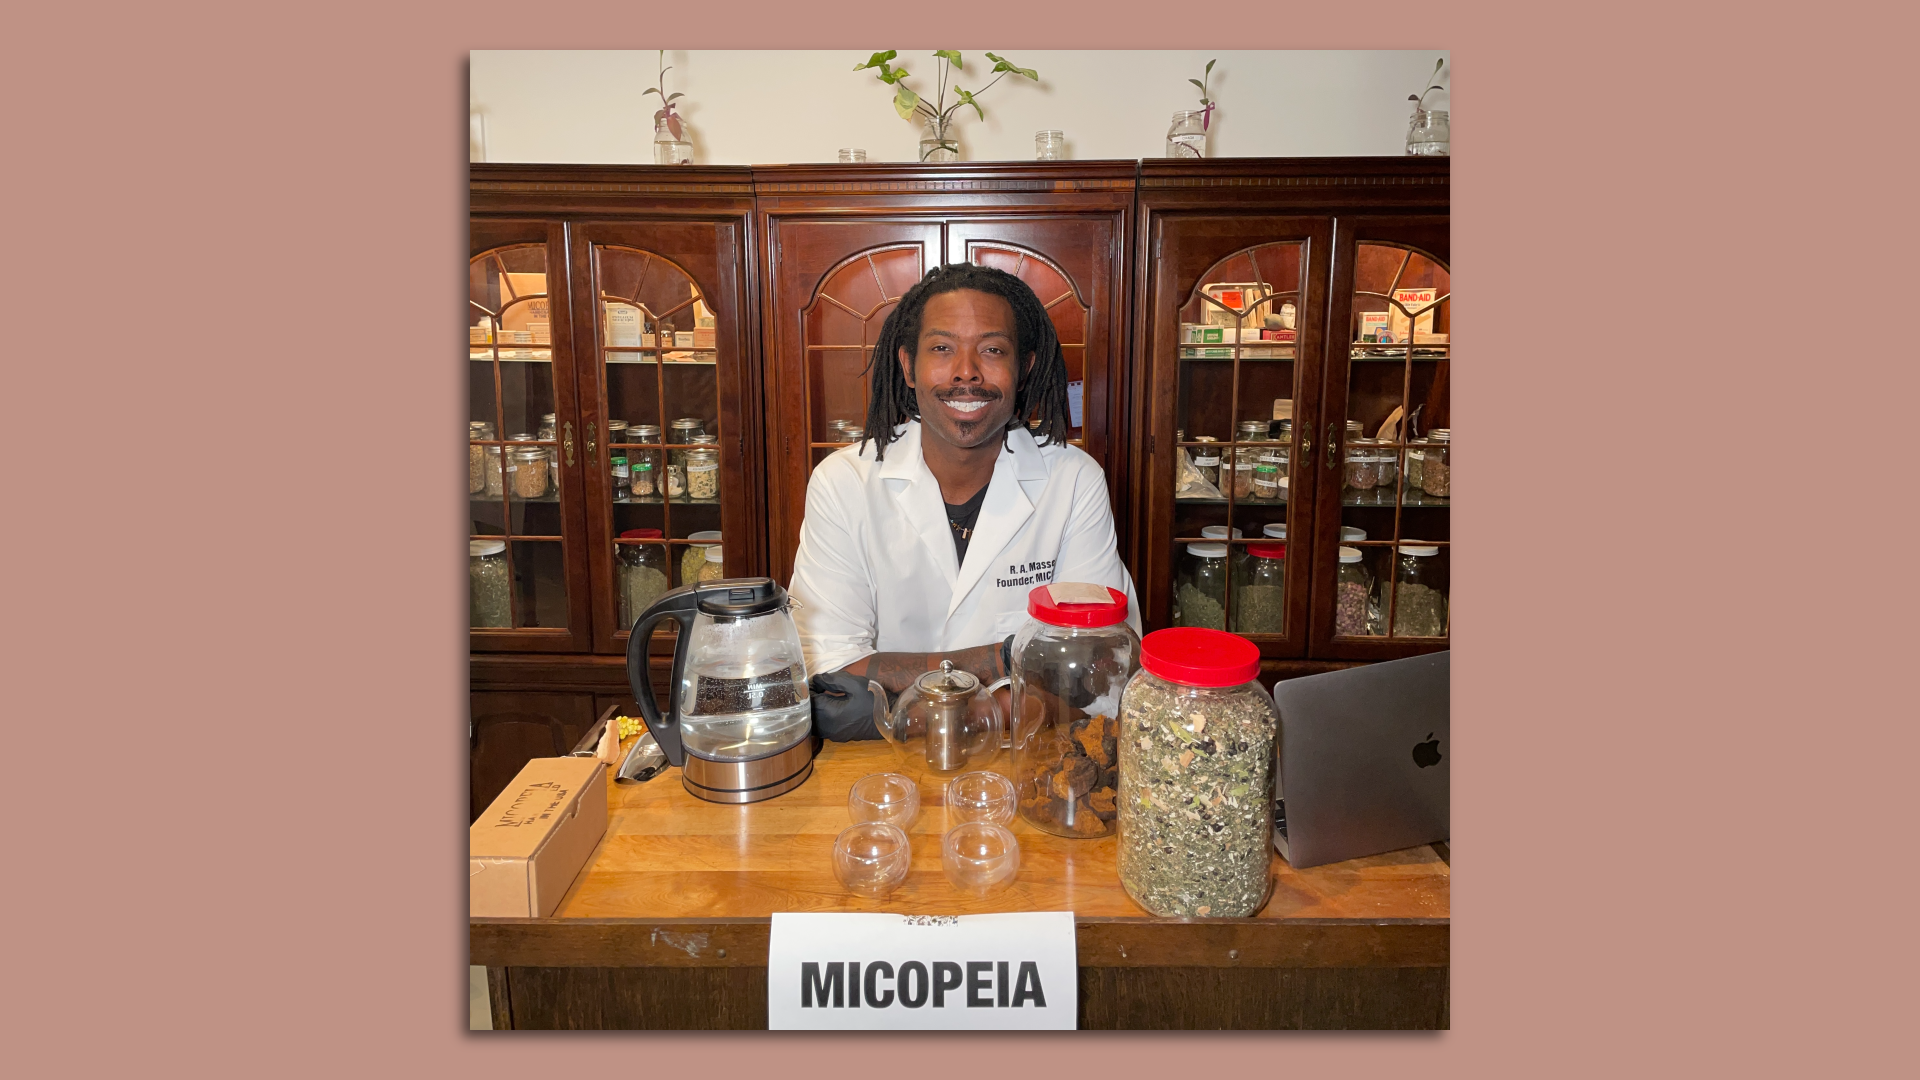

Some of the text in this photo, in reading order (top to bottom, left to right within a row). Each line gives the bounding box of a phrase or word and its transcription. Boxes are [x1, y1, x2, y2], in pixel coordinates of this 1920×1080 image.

[1400, 293, 1431, 302] BAND-AID
[1010, 565, 1018, 574] R.
[1020, 564, 1028, 573] A.
[996, 576, 1034, 588] Founder,
[801, 961, 1047, 1009] MICOPEIA
